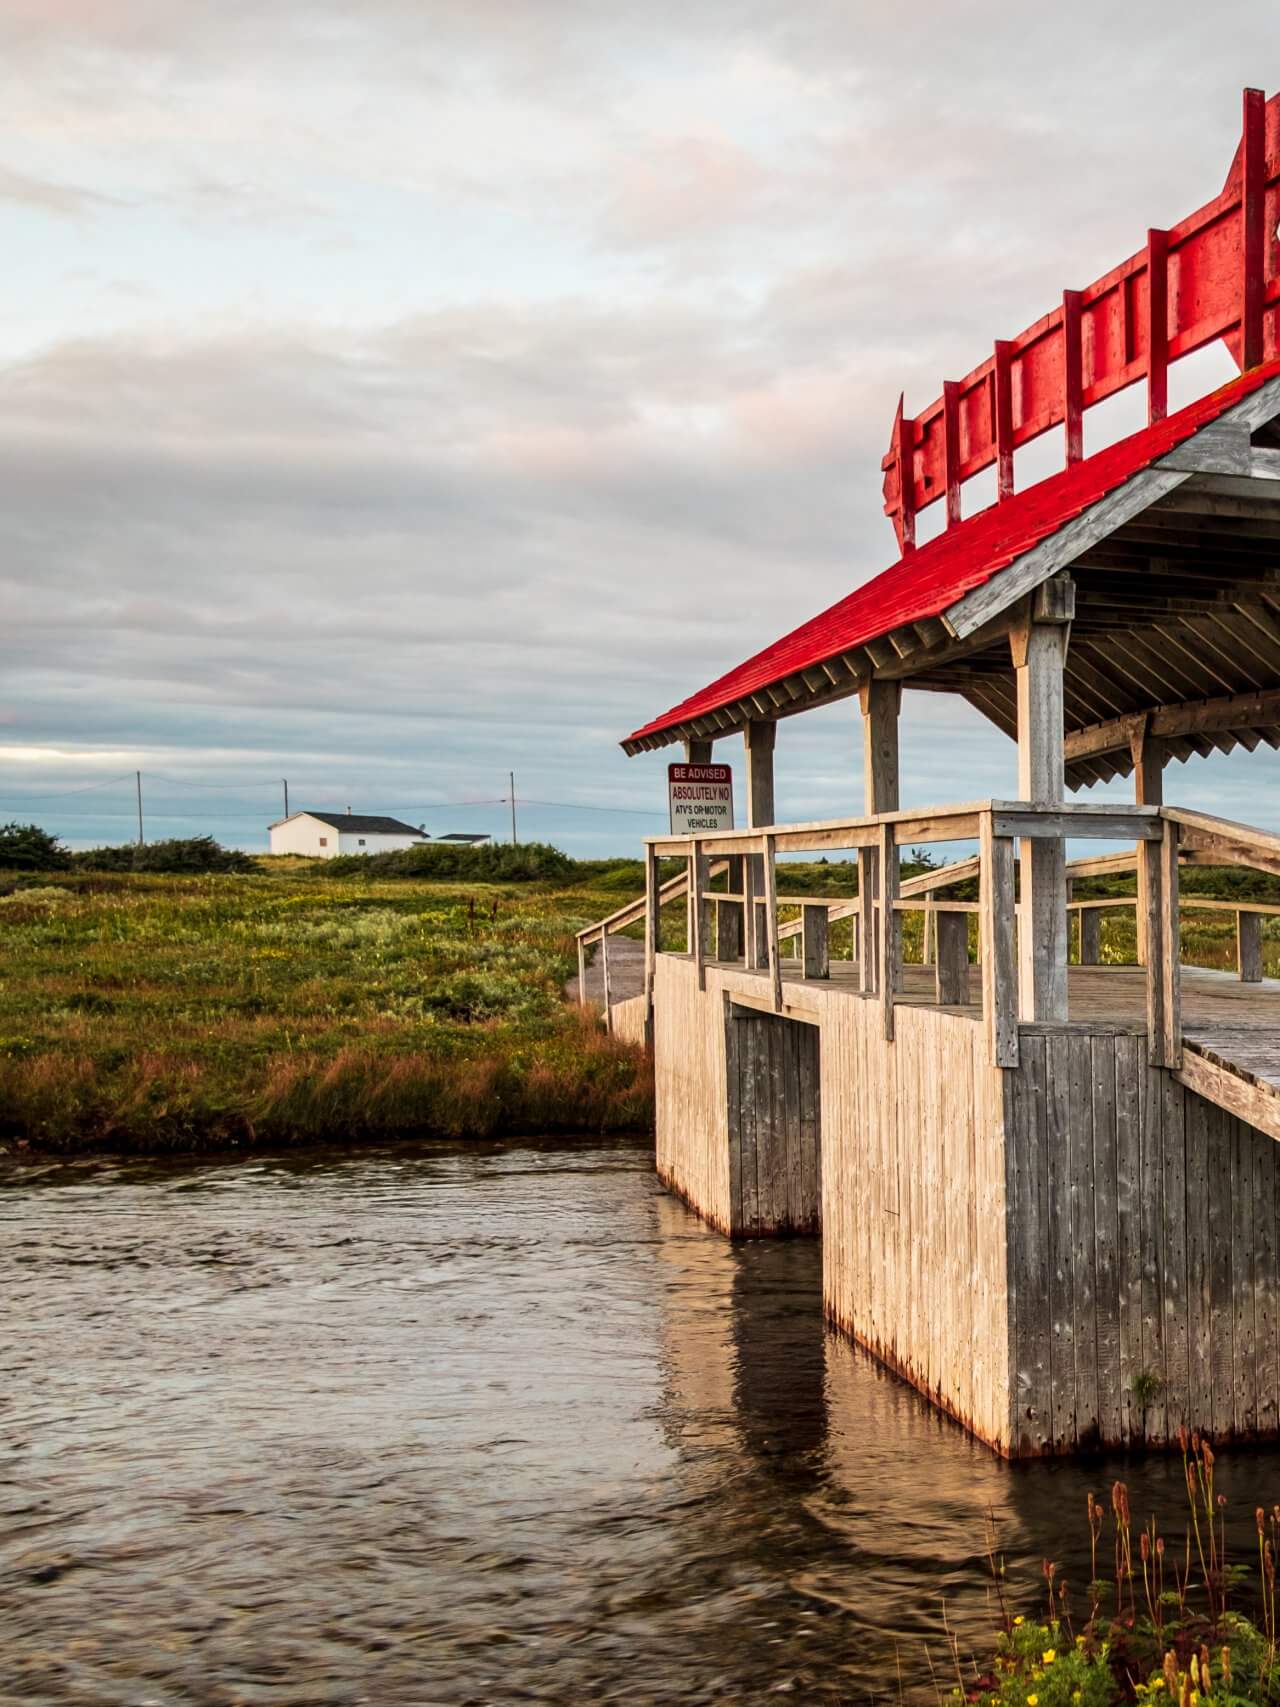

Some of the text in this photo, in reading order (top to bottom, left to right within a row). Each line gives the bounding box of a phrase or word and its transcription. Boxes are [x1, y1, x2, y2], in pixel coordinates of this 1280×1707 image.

[674, 768, 726, 779] BE ADVISED
[673, 786, 729, 800] ABSOLUTELY NO
[687, 818, 718, 828] VEHICLES
